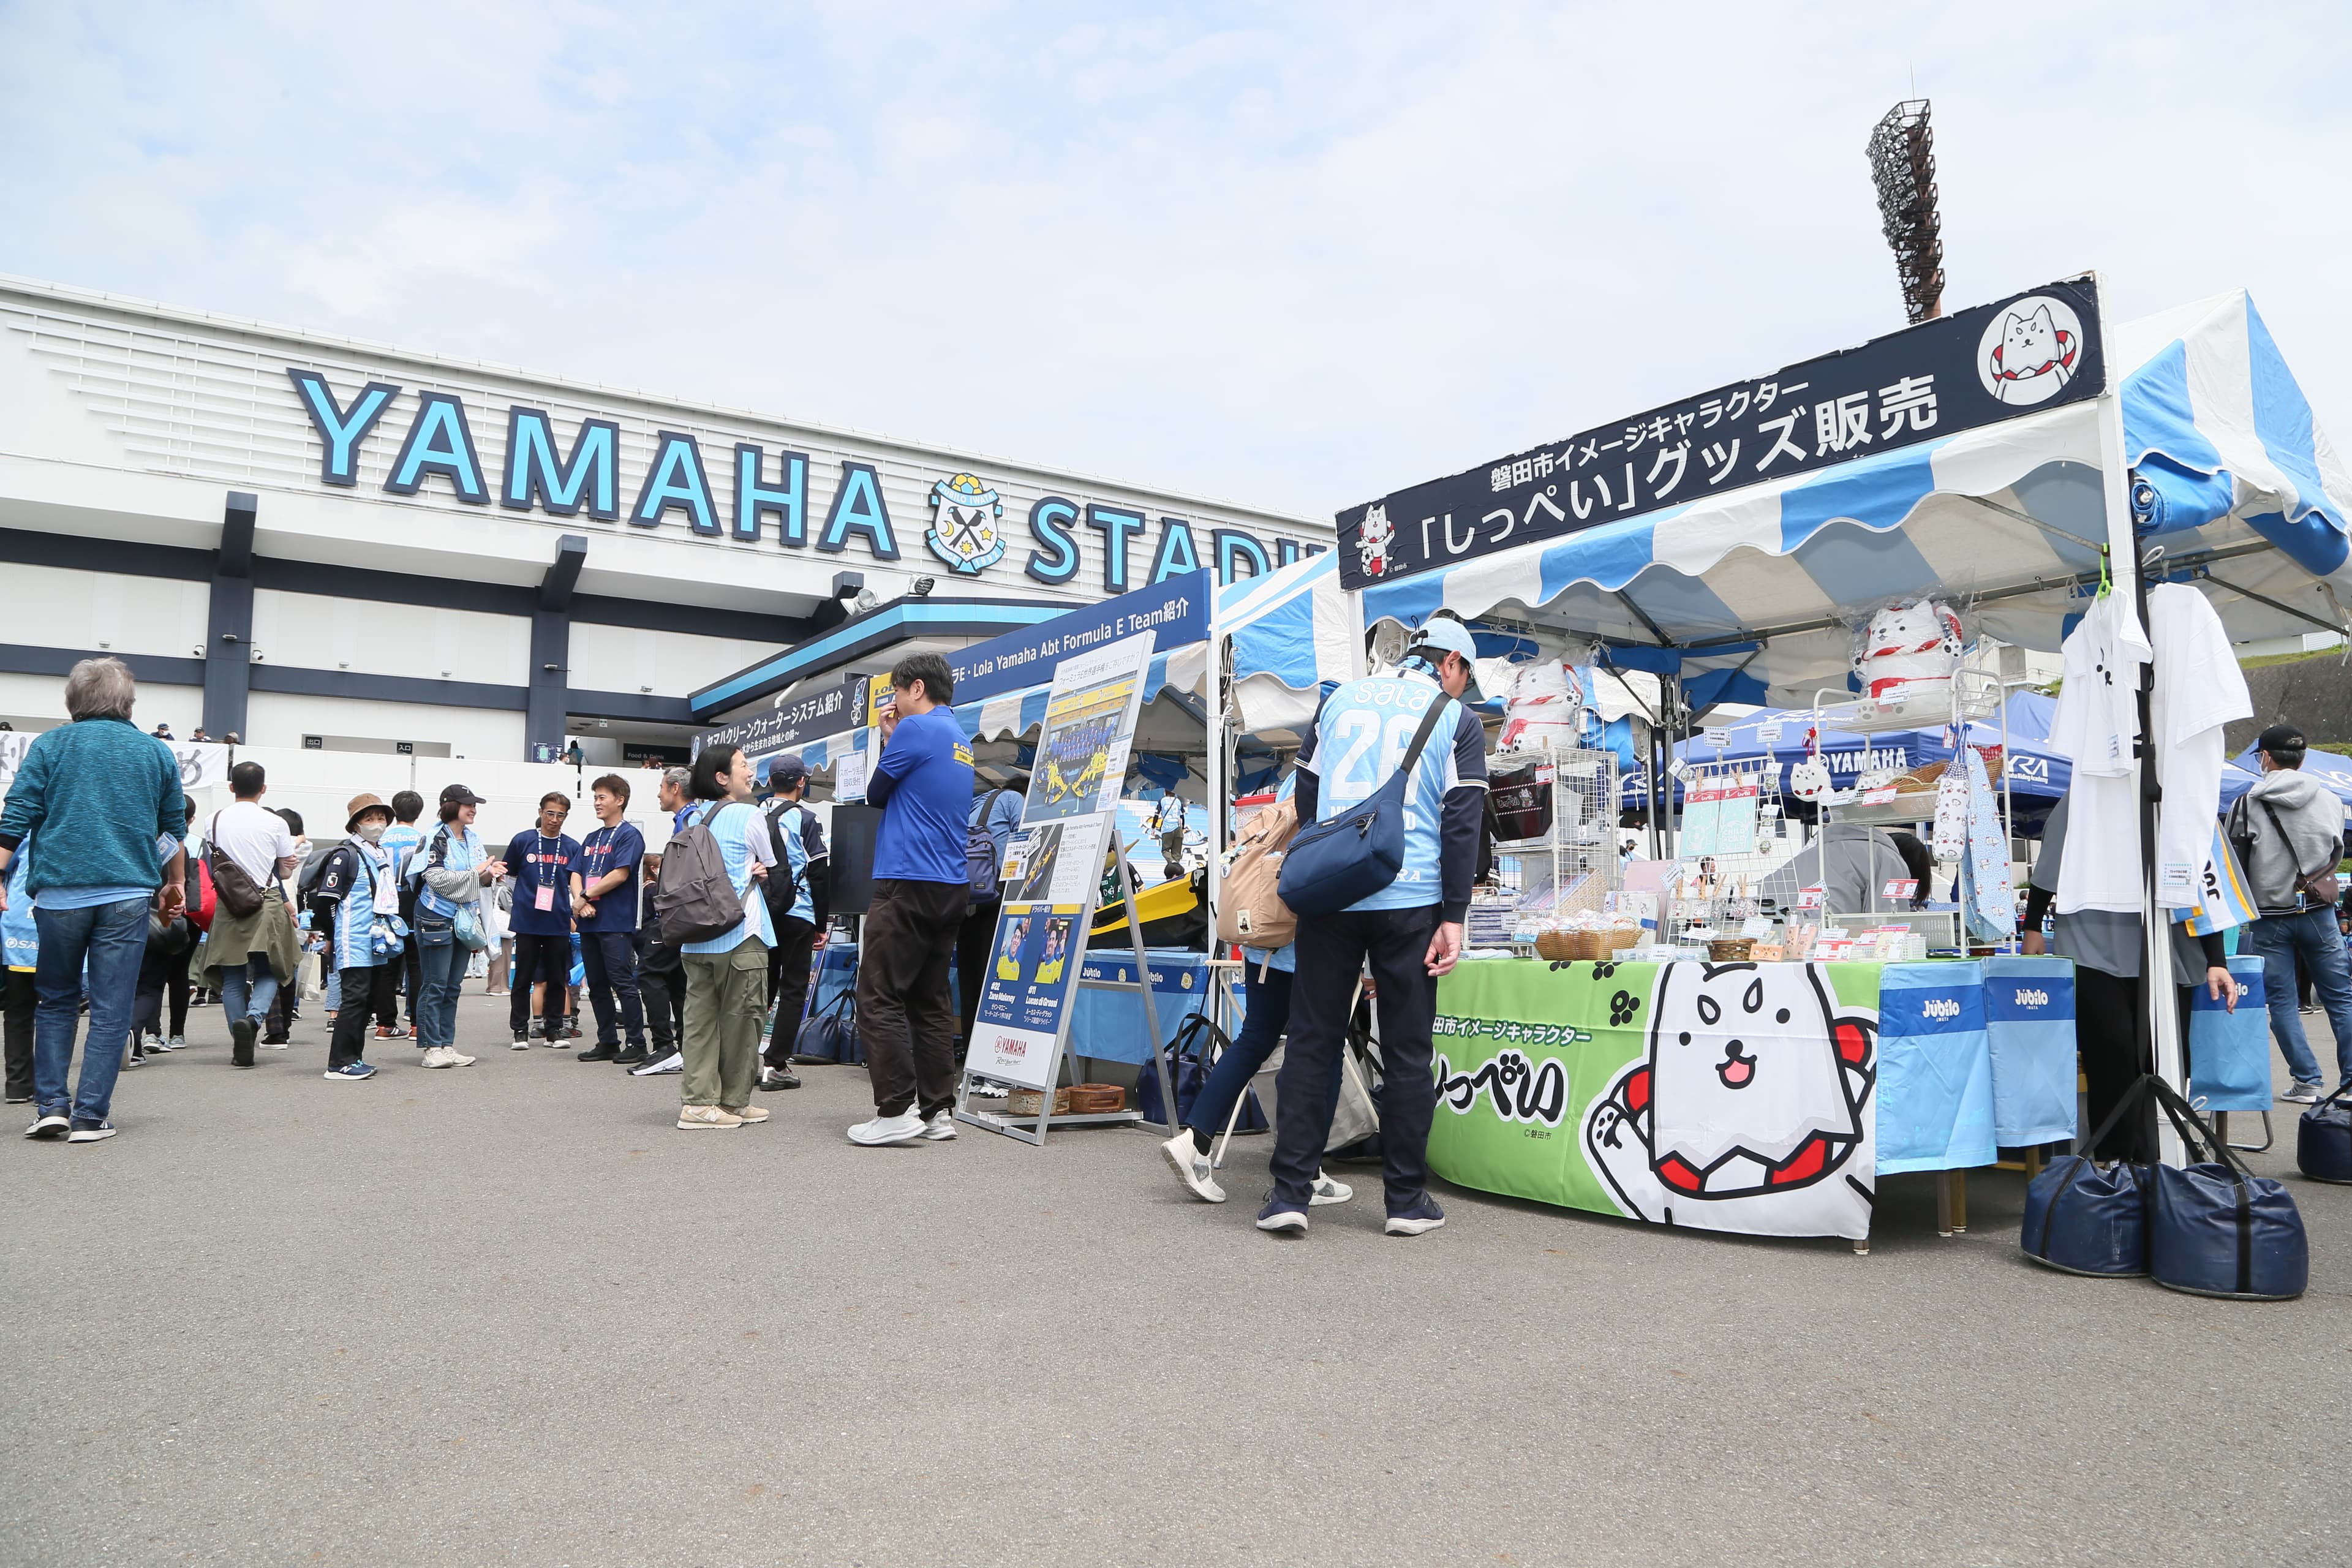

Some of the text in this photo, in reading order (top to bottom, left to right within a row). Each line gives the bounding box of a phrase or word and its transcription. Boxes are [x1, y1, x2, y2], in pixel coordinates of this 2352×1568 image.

[1490, 382, 1809, 492] 磐田市イメージキャラクター
[286, 368, 902, 562] YAMAHA
[1421, 374, 1939, 559] 「しっぺい」グッズ販売
[970, 494, 996, 505] IWATA
[933, 543, 1000, 568] SINCE 1992
[996, 646, 1038, 671] Yamaha
[1040, 637, 1060, 658] Abt
[1063, 623, 1112, 652] Formula
[1117, 618, 1124, 636] E
[1128, 597, 1189, 631] Team紹介
[1354, 682, 1431, 711] sala
[707, 690, 844, 747] ヤマハクリーンウォーターシステム紹介
[1329, 709, 1429, 806] 26
[1831, 747, 1907, 774] YAMAHA
[990, 981, 1001, 990] #22
[1082, 967, 1101, 979] Júbilo
[1025, 995, 1039, 1006] Lucas
[1028, 986, 1037, 995] #11
[2015, 988, 2049, 1006] Júbilo
[1923, 998, 1960, 1018] Júbilo
[1001, 1038, 1027, 1058] YAMAHA
